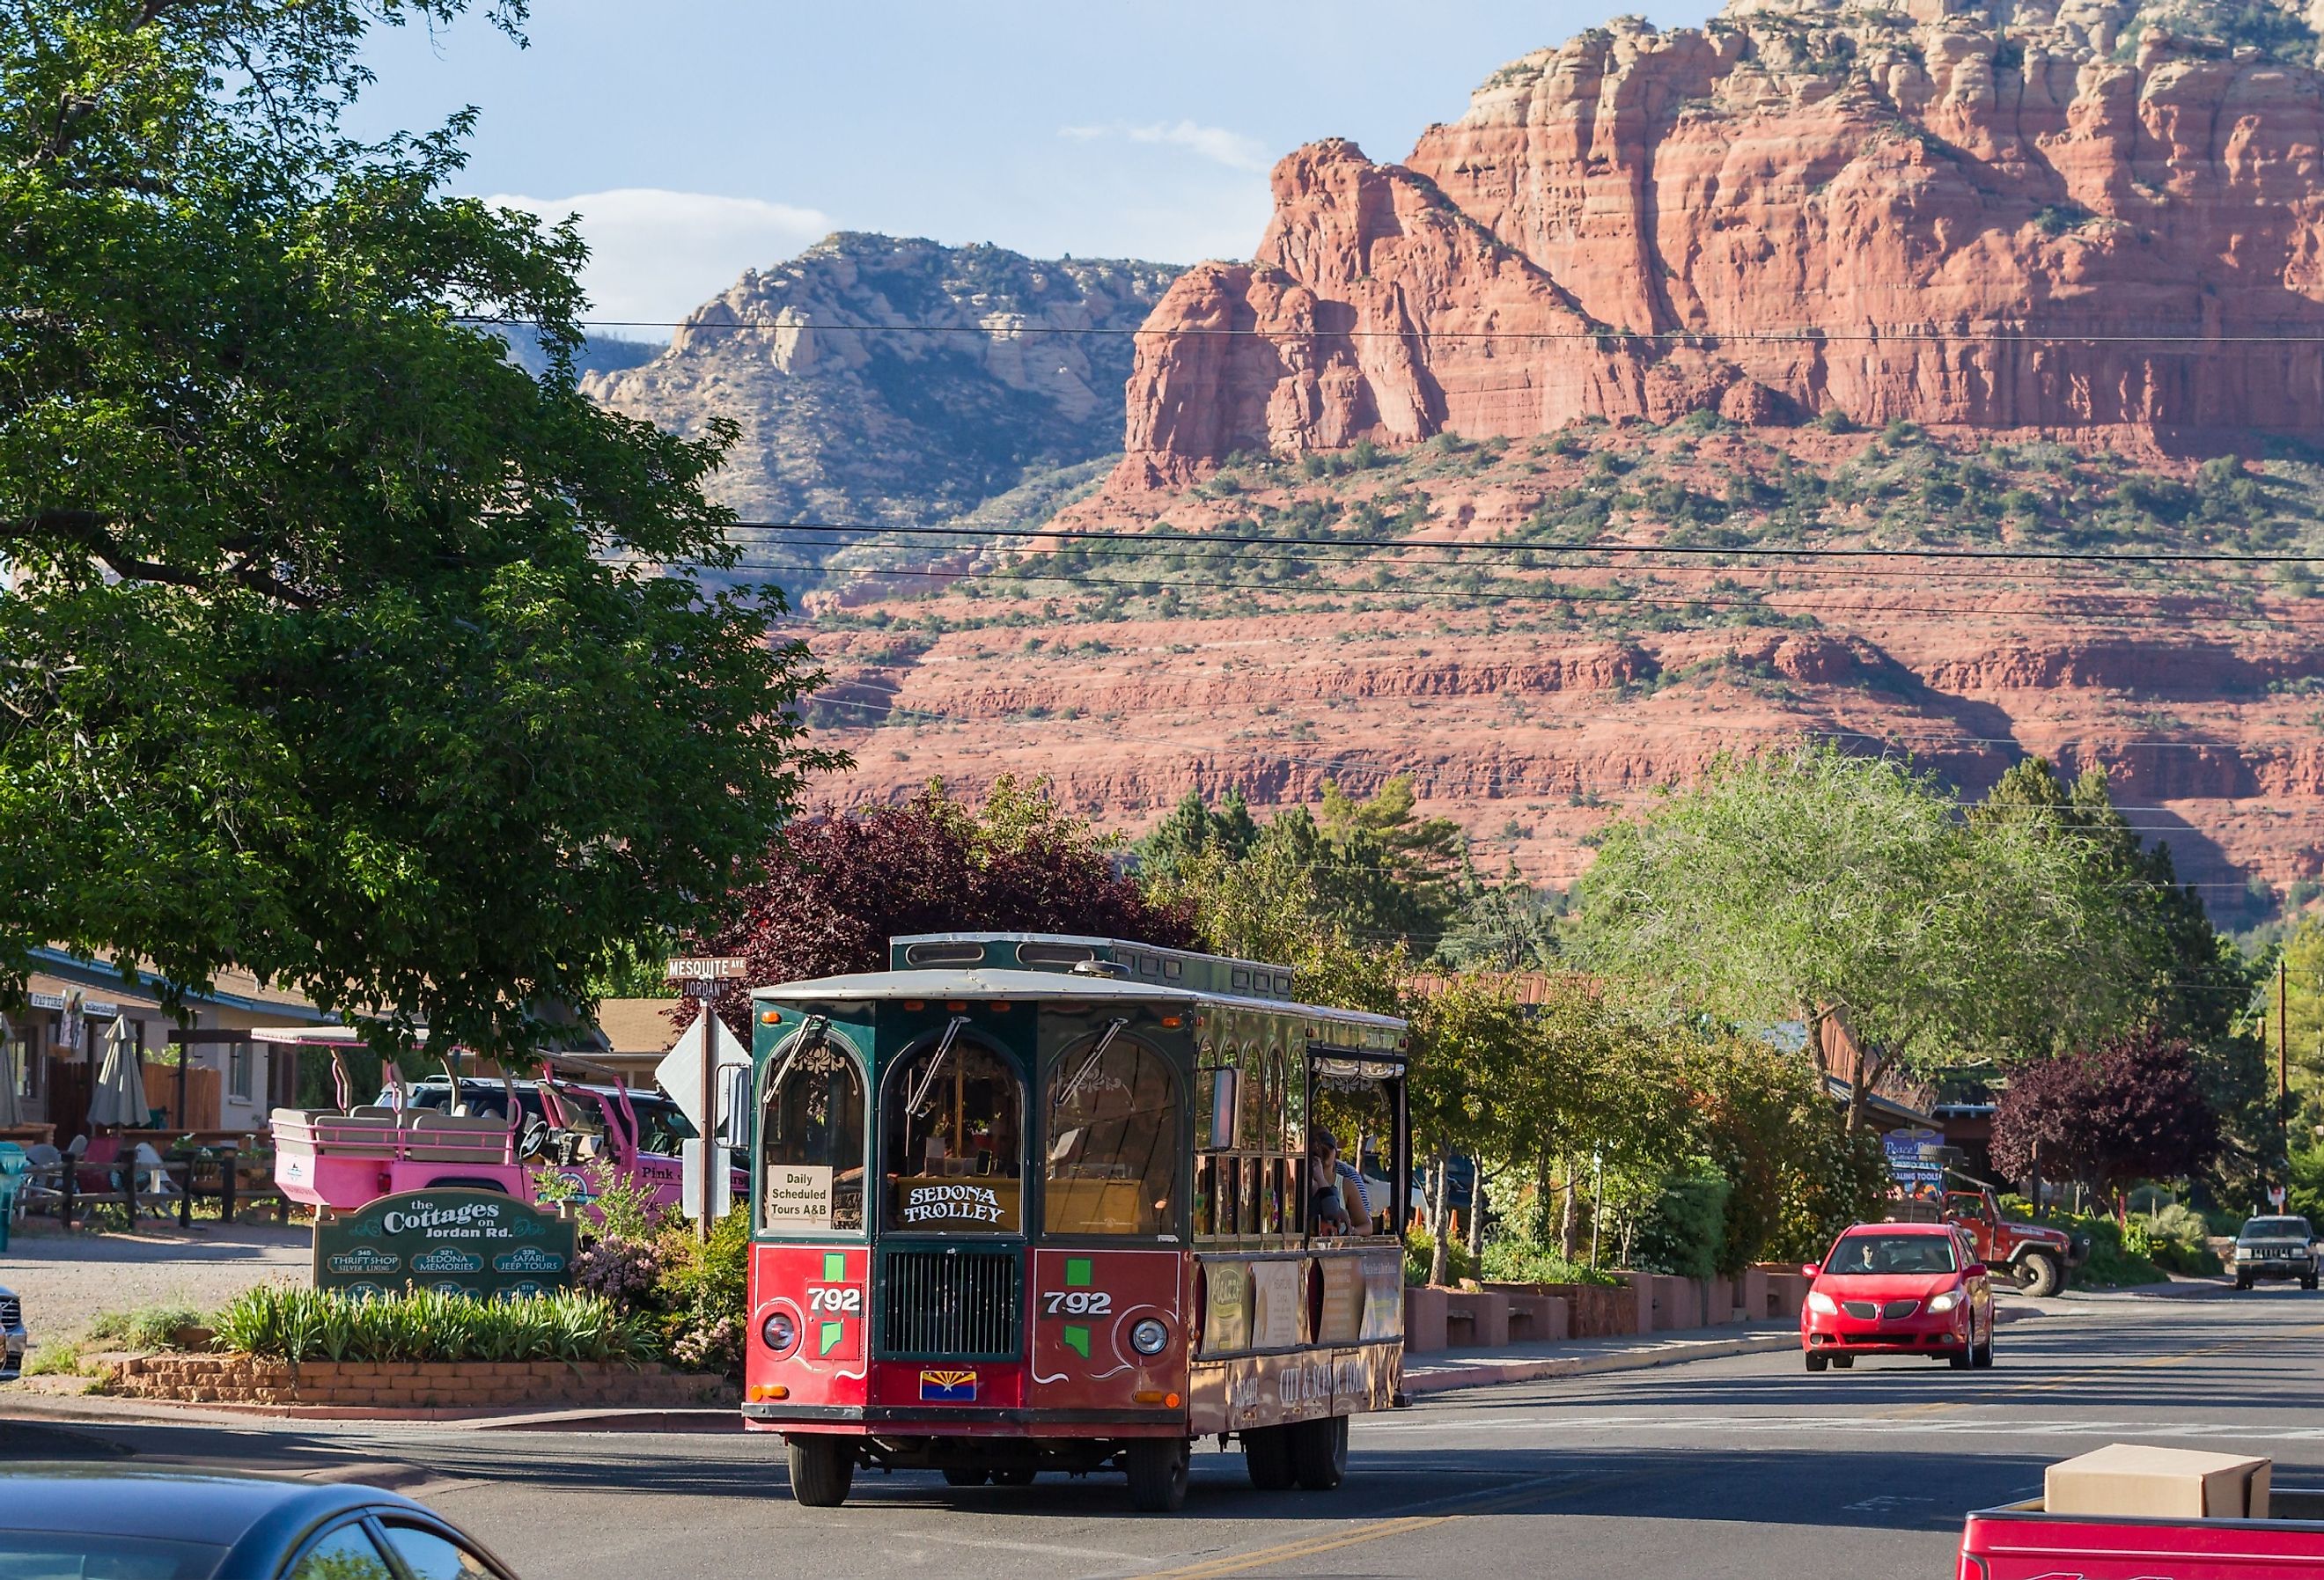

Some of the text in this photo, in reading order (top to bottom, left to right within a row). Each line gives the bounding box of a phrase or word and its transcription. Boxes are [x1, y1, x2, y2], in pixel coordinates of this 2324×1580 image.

[669, 959, 745, 975] MESQUITE AVE
[684, 981, 720, 996] JORDAN
[642, 1166, 673, 1180] Pink
[786, 1173, 813, 1185] Daily
[1917, 1172, 1939, 1181] TOOLS
[772, 1188, 827, 1200] Scheduled
[909, 1184, 999, 1207] SEDONA
[411, 1200, 433, 1209] the
[772, 1204, 826, 1216] Tours A&B
[383, 1203, 499, 1233] Cottages
[904, 1202, 1004, 1224] TROLLEY
[478, 1218, 495, 1227] on
[425, 1227, 513, 1238] Jordan Rd.
[334, 1256, 398, 1265] THRIFT SHOP
[420, 1262, 474, 1271] MEMORIES
[500, 1262, 522, 1271] JEEP
[807, 1287, 860, 1312] 792
[1042, 1290, 1112, 1314] 792
[1279, 1367, 1301, 1403] CITY
[1302, 1367, 1311, 1400] &
